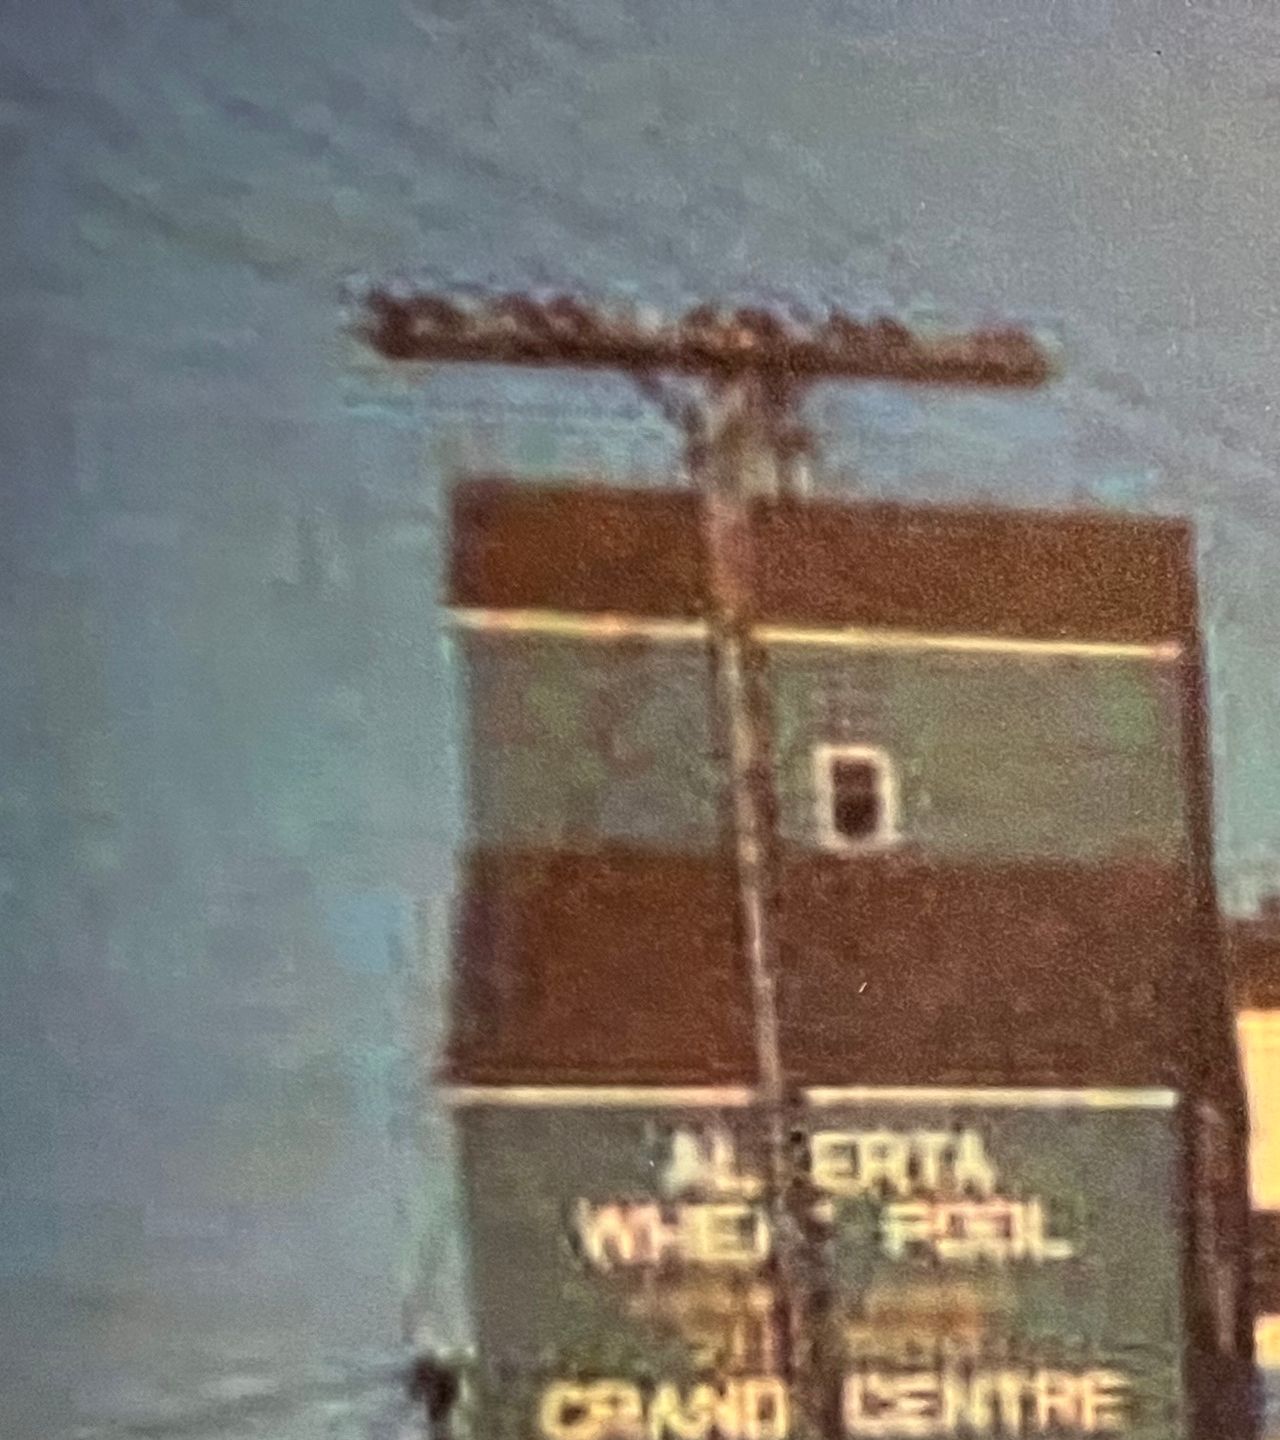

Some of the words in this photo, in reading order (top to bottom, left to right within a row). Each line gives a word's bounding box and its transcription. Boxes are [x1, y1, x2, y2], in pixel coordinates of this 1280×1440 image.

[660, 1128, 996, 1196] ALERTA
[572, 1198, 836, 1266] WHE
[842, 1368, 1130, 1438] CENTRE
